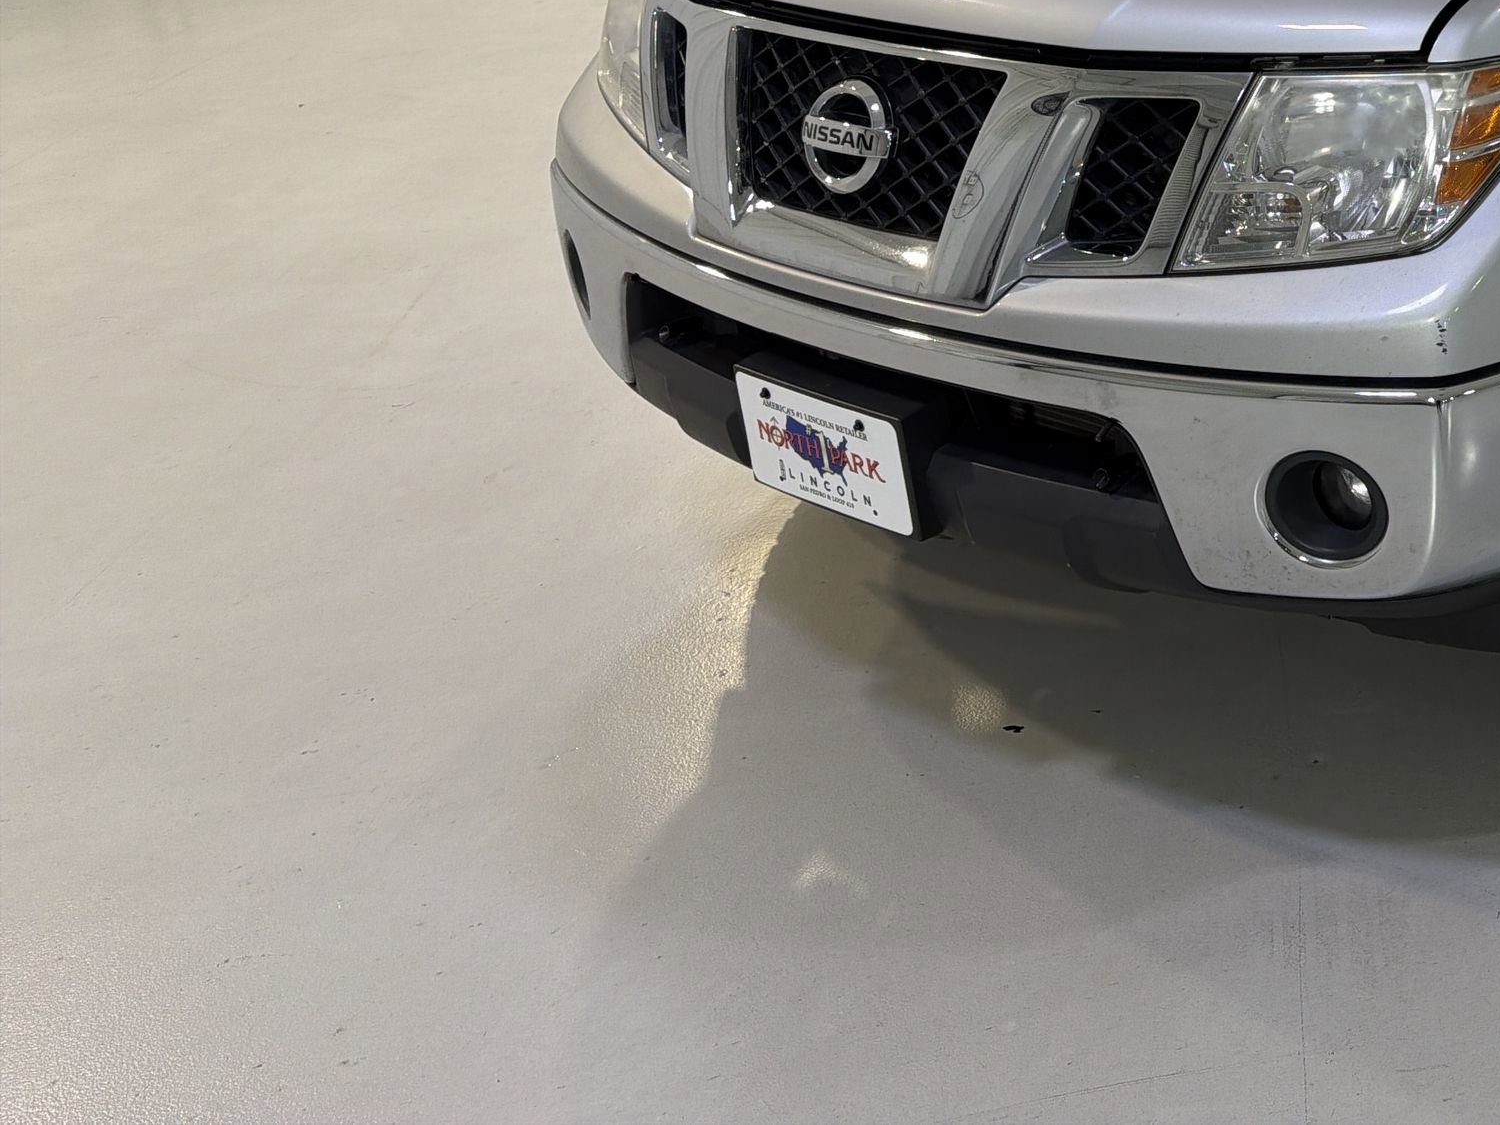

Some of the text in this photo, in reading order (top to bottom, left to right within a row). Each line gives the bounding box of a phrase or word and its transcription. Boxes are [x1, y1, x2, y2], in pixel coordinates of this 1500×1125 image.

[803, 121, 874, 151] NISSAN
[762, 399, 795, 416] AMERICA'S
[803, 413, 835, 430] LINCOLN
[834, 424, 868, 442] RETAILER
[756, 418, 887, 484] NORTH PARK
[788, 467, 872, 507] LINCOLN
